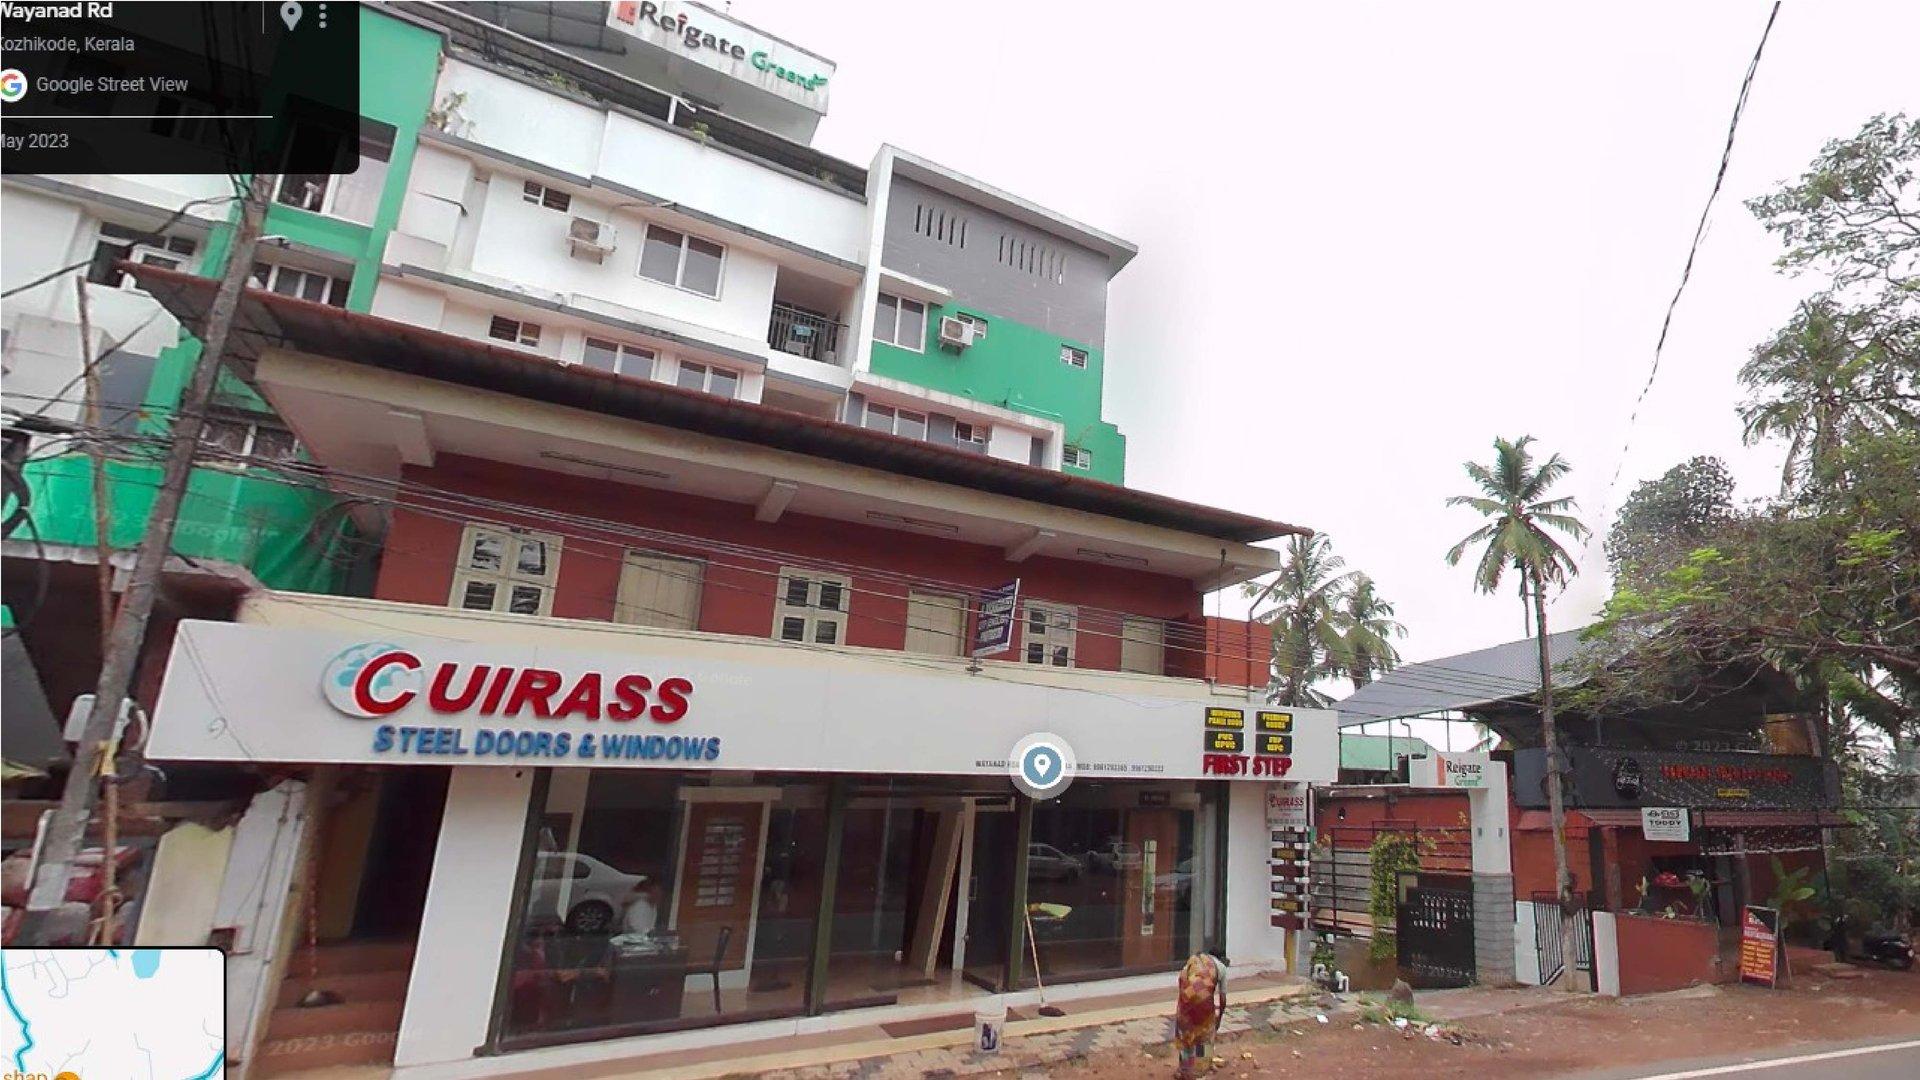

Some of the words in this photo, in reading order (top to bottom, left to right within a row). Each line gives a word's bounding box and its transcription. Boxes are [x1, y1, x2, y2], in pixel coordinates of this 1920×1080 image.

[639, 0, 745, 60] Reigate
[751, 51, 823, 91] Greens
[353, 651, 695, 723] CUIRASS
[373, 724, 468, 756] STEEL
[474, 727, 572, 758] DOORS
[577, 730, 597, 758] &
[602, 732, 721, 761] WINDOWS
[1203, 754, 1250, 776] FIRST
[1252, 755, 1292, 777] STEP
[1446, 759, 1482, 778] Reigate
